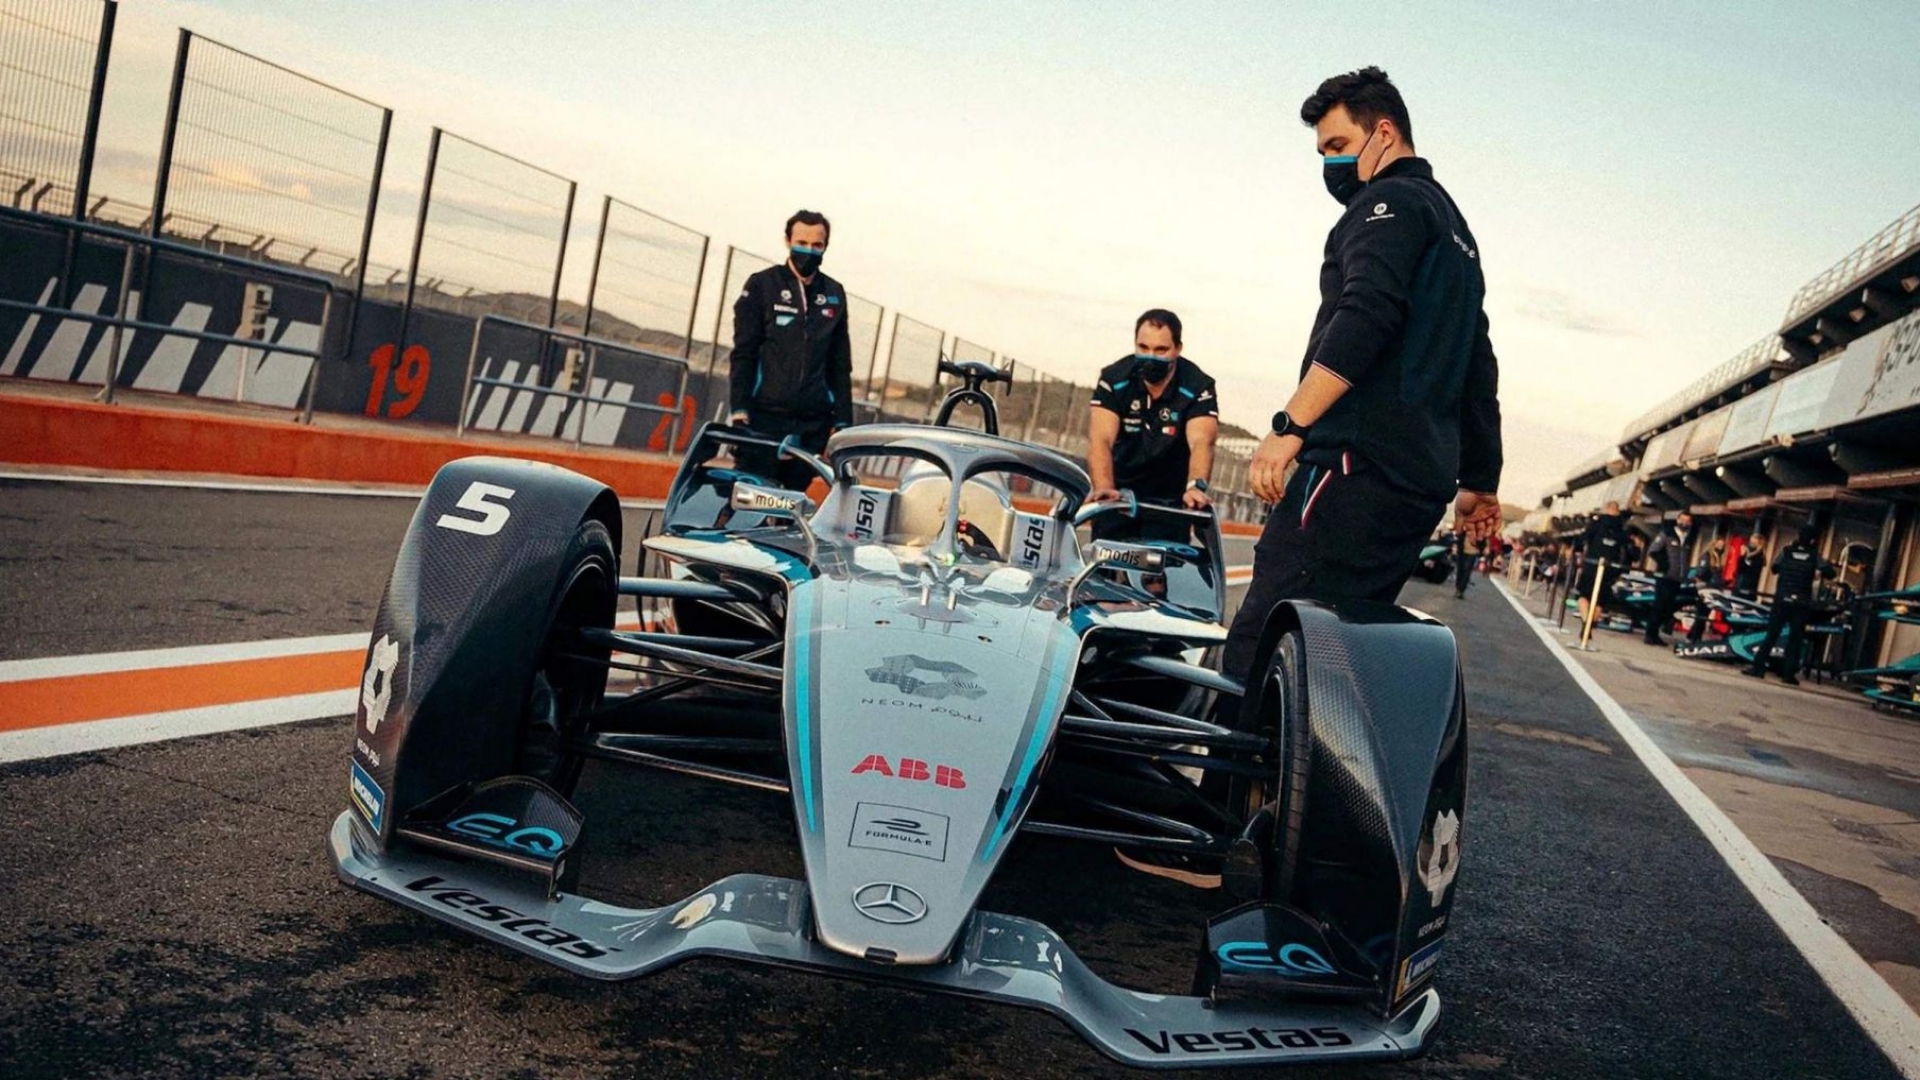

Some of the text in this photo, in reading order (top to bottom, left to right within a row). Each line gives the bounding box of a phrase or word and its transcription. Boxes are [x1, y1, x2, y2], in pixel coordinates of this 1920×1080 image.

[365, 342, 431, 419] 19
[436, 480, 516, 536] 5
[756, 493, 796, 510] modis
[1099, 546, 1140, 565] modis
[861, 698, 922, 708] NEOM
[851, 754, 967, 789] ABB
[447, 812, 564, 854] EQ
[865, 830, 922, 844] FORMULA
[404, 876, 624, 959] Vestas
[1217, 941, 1338, 976] EQ
[1121, 1026, 1353, 1055] Vestas
